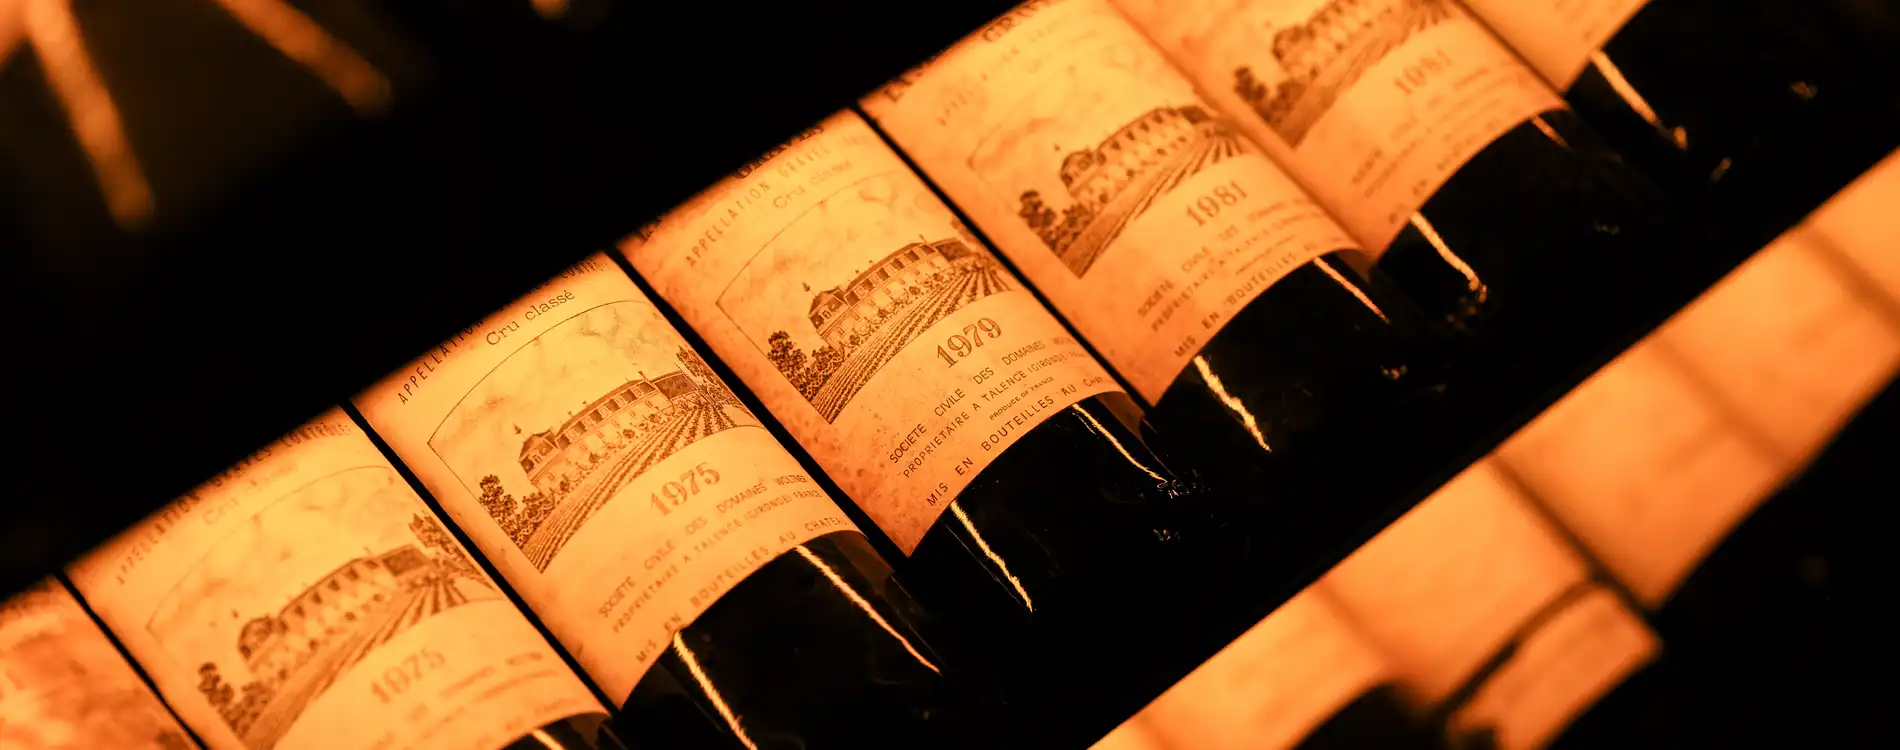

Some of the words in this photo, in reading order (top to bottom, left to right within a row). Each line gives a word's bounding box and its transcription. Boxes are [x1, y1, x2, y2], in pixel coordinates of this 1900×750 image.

[686, 181, 770, 266] APPELLATION
[1186, 180, 1248, 227] 1981
[486, 319, 521, 346] Cru
[524, 289, 575, 321] classé
[936, 317, 1002, 368] 1979
[889, 423, 927, 464] SOCIETE
[934, 388, 965, 417] CIVILE
[972, 367, 995, 385] DES
[1001, 340, 1046, 366] DOMAINES
[903, 412, 970, 479] PROPRIETAIRE
[972, 402, 981, 411] A
[981, 369, 1027, 402] TALENCE
[989, 396, 1020, 420] PRODUCE
[1020, 390, 1029, 398] OF
[1030, 376, 1054, 391] FRANCE
[926, 482, 948, 506] MIS
[955, 457, 974, 476] EN
[980, 395, 1054, 451] BOUTEILLES
[1061, 384, 1077, 396] AU
[651, 462, 720, 516] 1975
[599, 576, 636, 618] SOCIETE
[643, 540, 676, 570] CIVILE
[685, 516, 708, 535] DES
[717, 480, 768, 514] DOMAINES
[693, 518, 742, 553] TALENCE
[636, 640, 657, 664] MIS
[663, 612, 682, 632] EN
[690, 545, 770, 609] BOUTEILLES
[779, 531, 796, 545] AU
